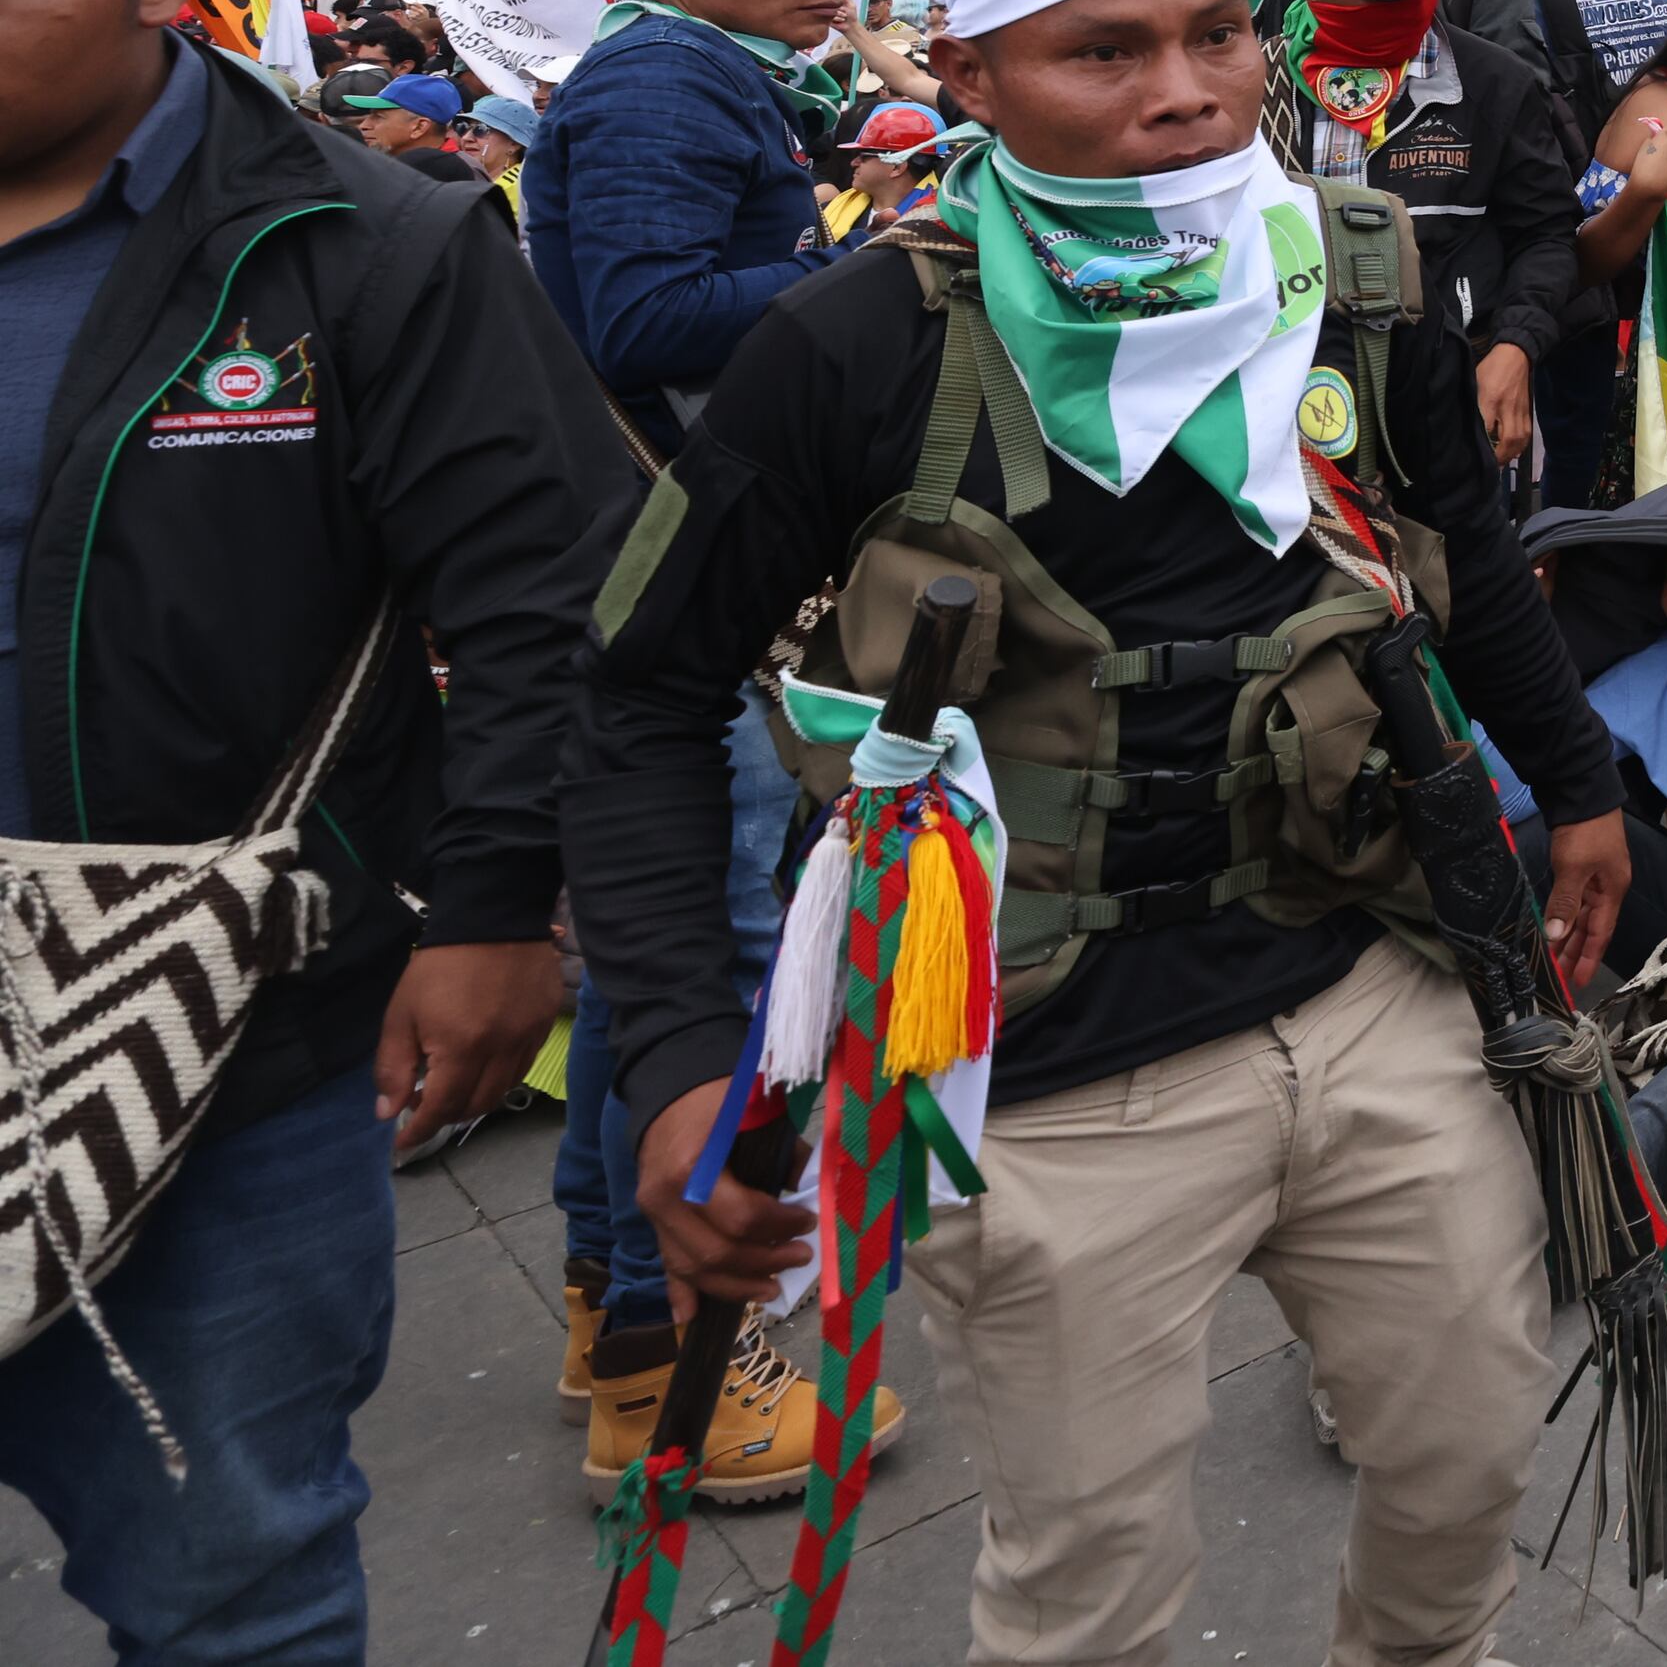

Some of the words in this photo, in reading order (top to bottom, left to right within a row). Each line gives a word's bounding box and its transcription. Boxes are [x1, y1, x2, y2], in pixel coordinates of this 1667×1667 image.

[1389, 149, 1473, 171] ADVENTURE
[221, 374, 257, 390] CRIC
[148, 426, 317, 450] COMUNICACIONES
